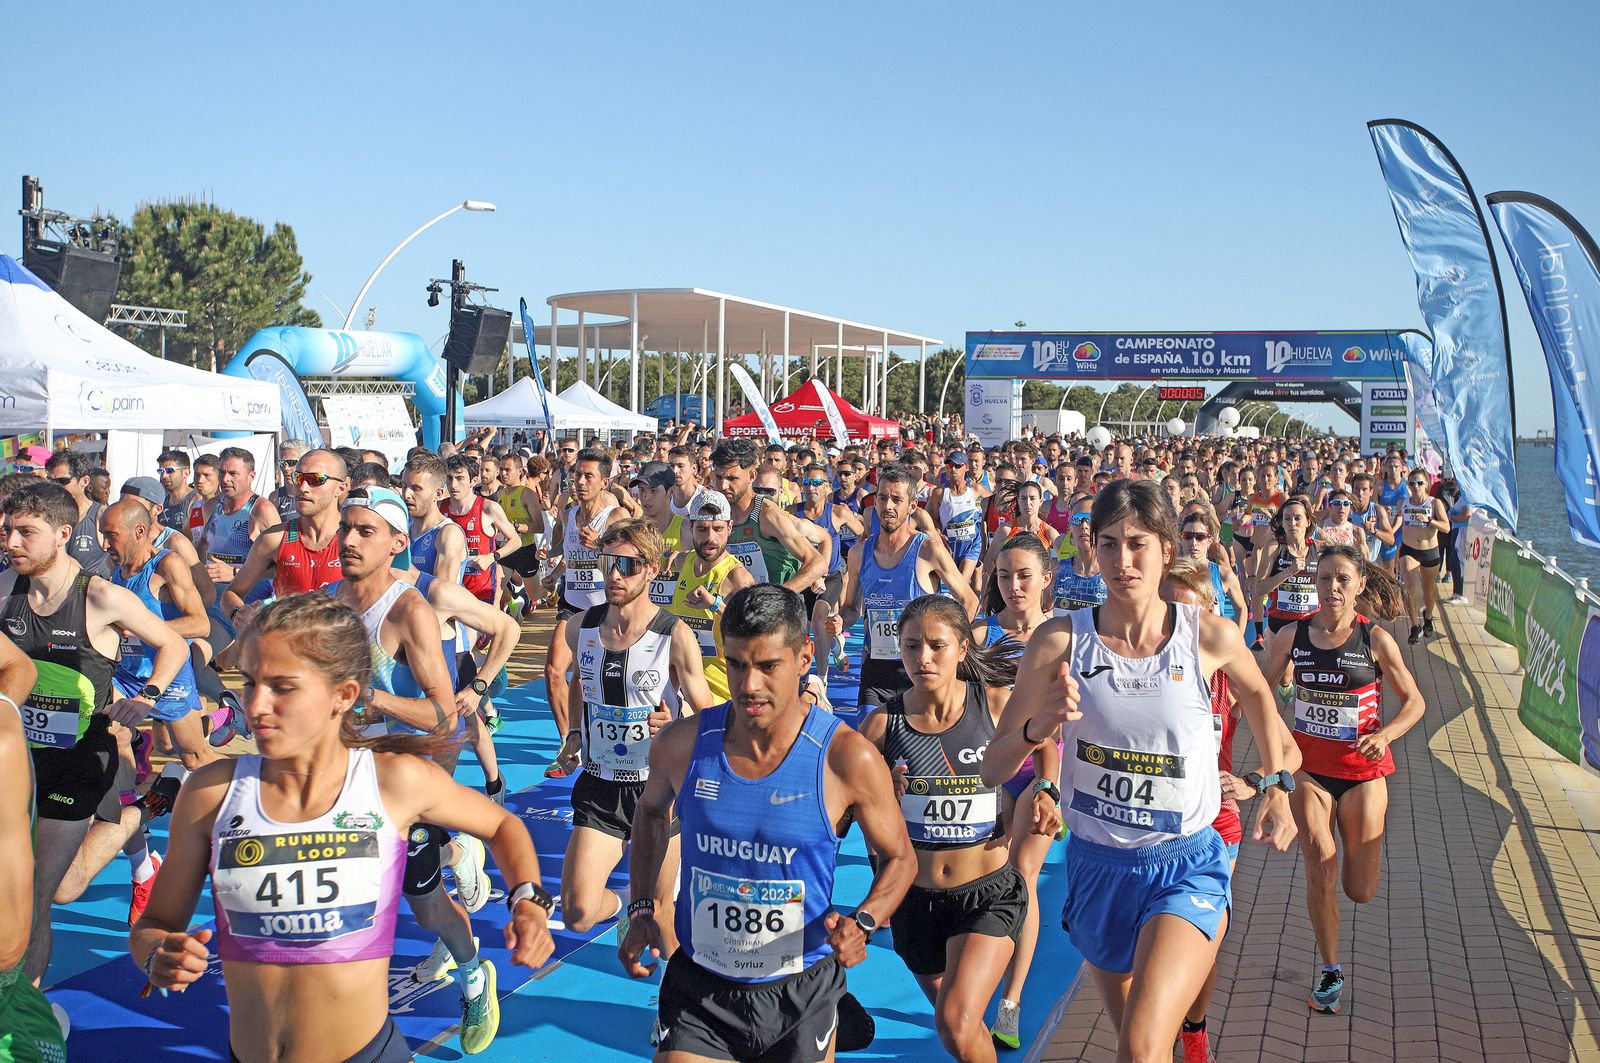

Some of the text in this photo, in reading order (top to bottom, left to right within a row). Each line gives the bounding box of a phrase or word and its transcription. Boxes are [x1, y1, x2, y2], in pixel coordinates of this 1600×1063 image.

[1116, 338, 1215, 350] CAMPEONATO
[1115, 350, 1251, 366] de ESPAÑA 10 km
[1290, 347, 1333, 360] HUELVA
[1076, 362, 1097, 370] WiHu
[574, 570, 594, 582] 183
[1288, 593, 1310, 604] 489
[1116, 681, 1159, 689] VALENCIA
[1317, 673, 1344, 685] BM
[1313, 692, 1351, 701] RUNNING
[36, 702, 62, 711] LOOP
[627, 710, 648, 720] 2023
[1305, 705, 1339, 725] 498
[597, 721, 645, 742] 1373
[1112, 750, 1174, 766] RUNNING
[1127, 763, 1164, 776] LOOP
[948, 787, 978, 795] LOOP
[1096, 772, 1156, 806] 404
[923, 799, 974, 822] 407
[218, 829, 252, 839] VIATOR
[275, 832, 360, 848] RUNNING
[297, 846, 348, 861] LOOP
[696, 832, 798, 865] URUGUAY
[255, 866, 340, 908] 415
[760, 886, 793, 902] 2023
[706, 902, 785, 935] 1886
[724, 937, 765, 948] CRISTHIAN
[727, 946, 760, 956] ZAMORA
[734, 959, 765, 970] Syrluz
